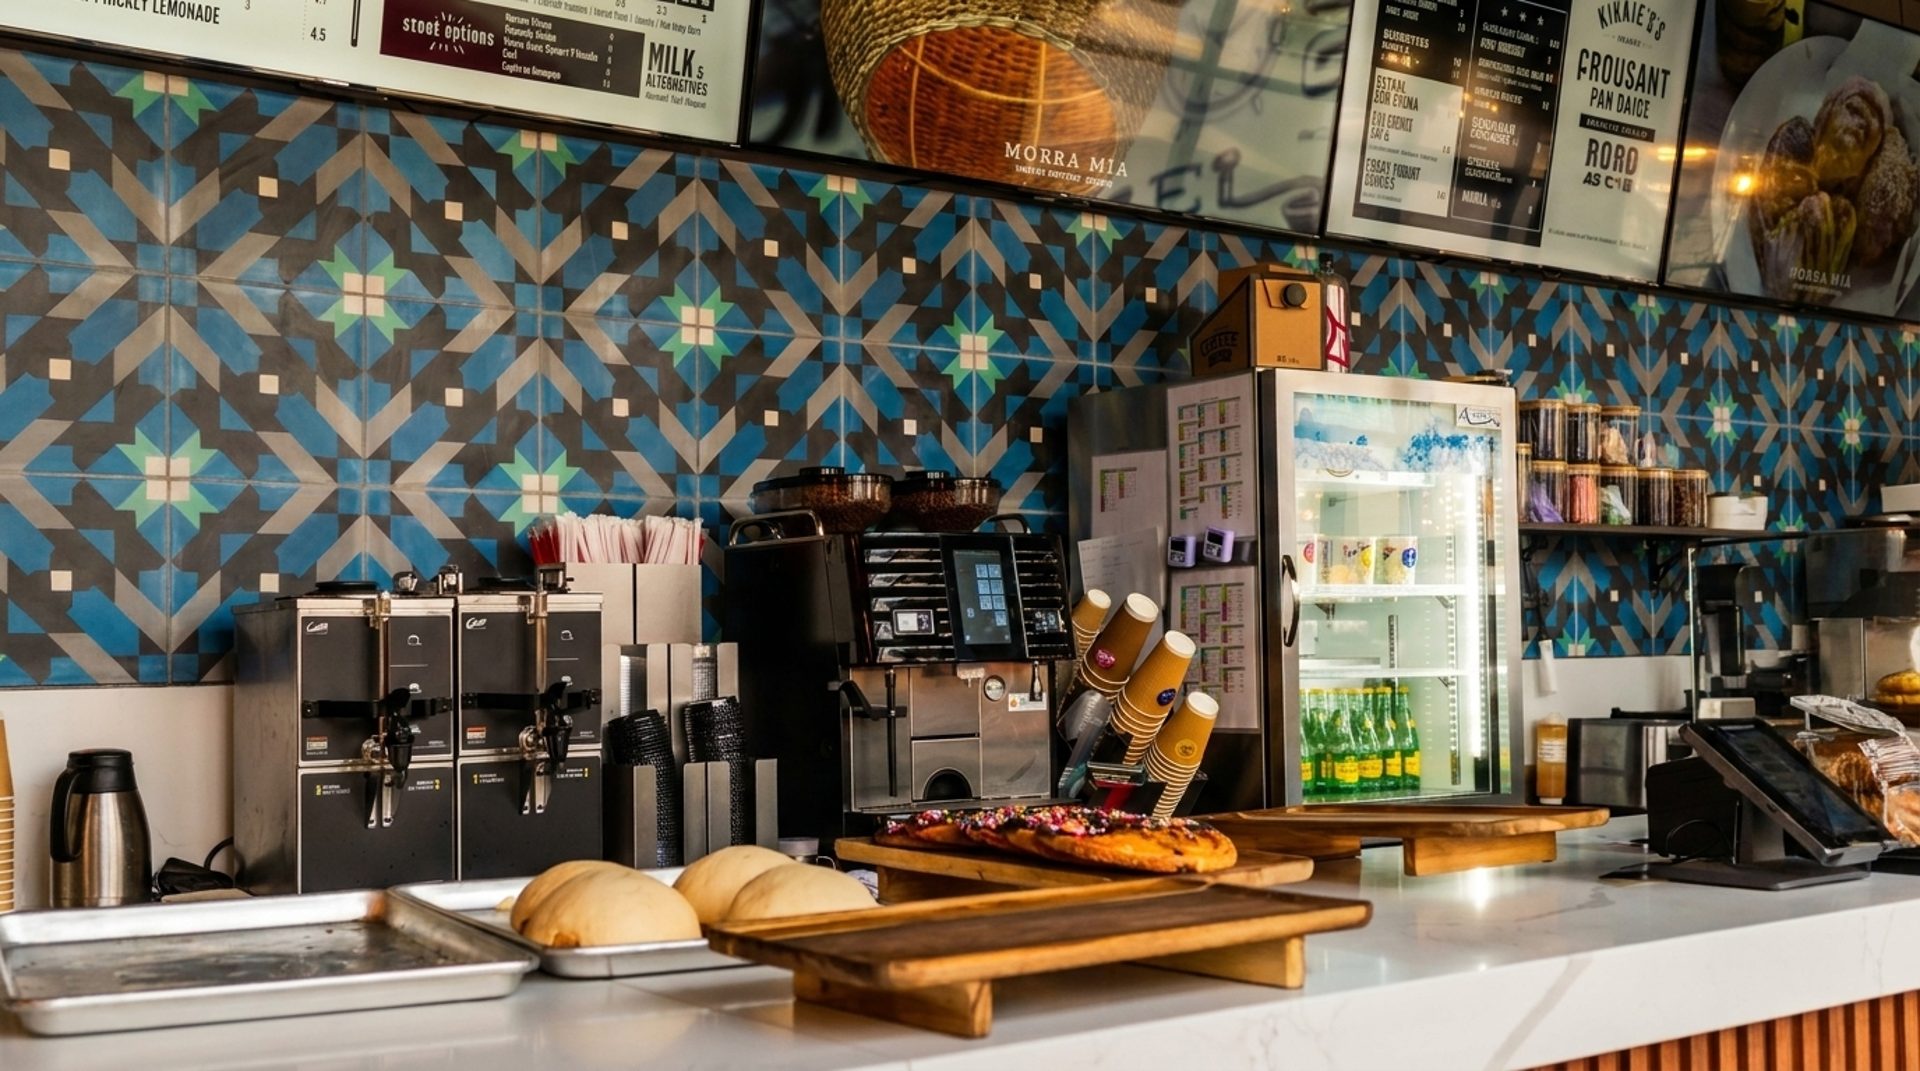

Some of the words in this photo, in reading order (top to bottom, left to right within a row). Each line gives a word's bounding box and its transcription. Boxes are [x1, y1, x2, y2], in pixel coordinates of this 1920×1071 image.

[152, 0, 221, 24] LEMONADE
[310, 27, 326, 41] 4.5
[648, 42, 695, 78] MILK
[1589, 87, 1614, 111] PAN
[1004, 141, 1080, 169] MORRA
[1089, 156, 1128, 178] MIA
